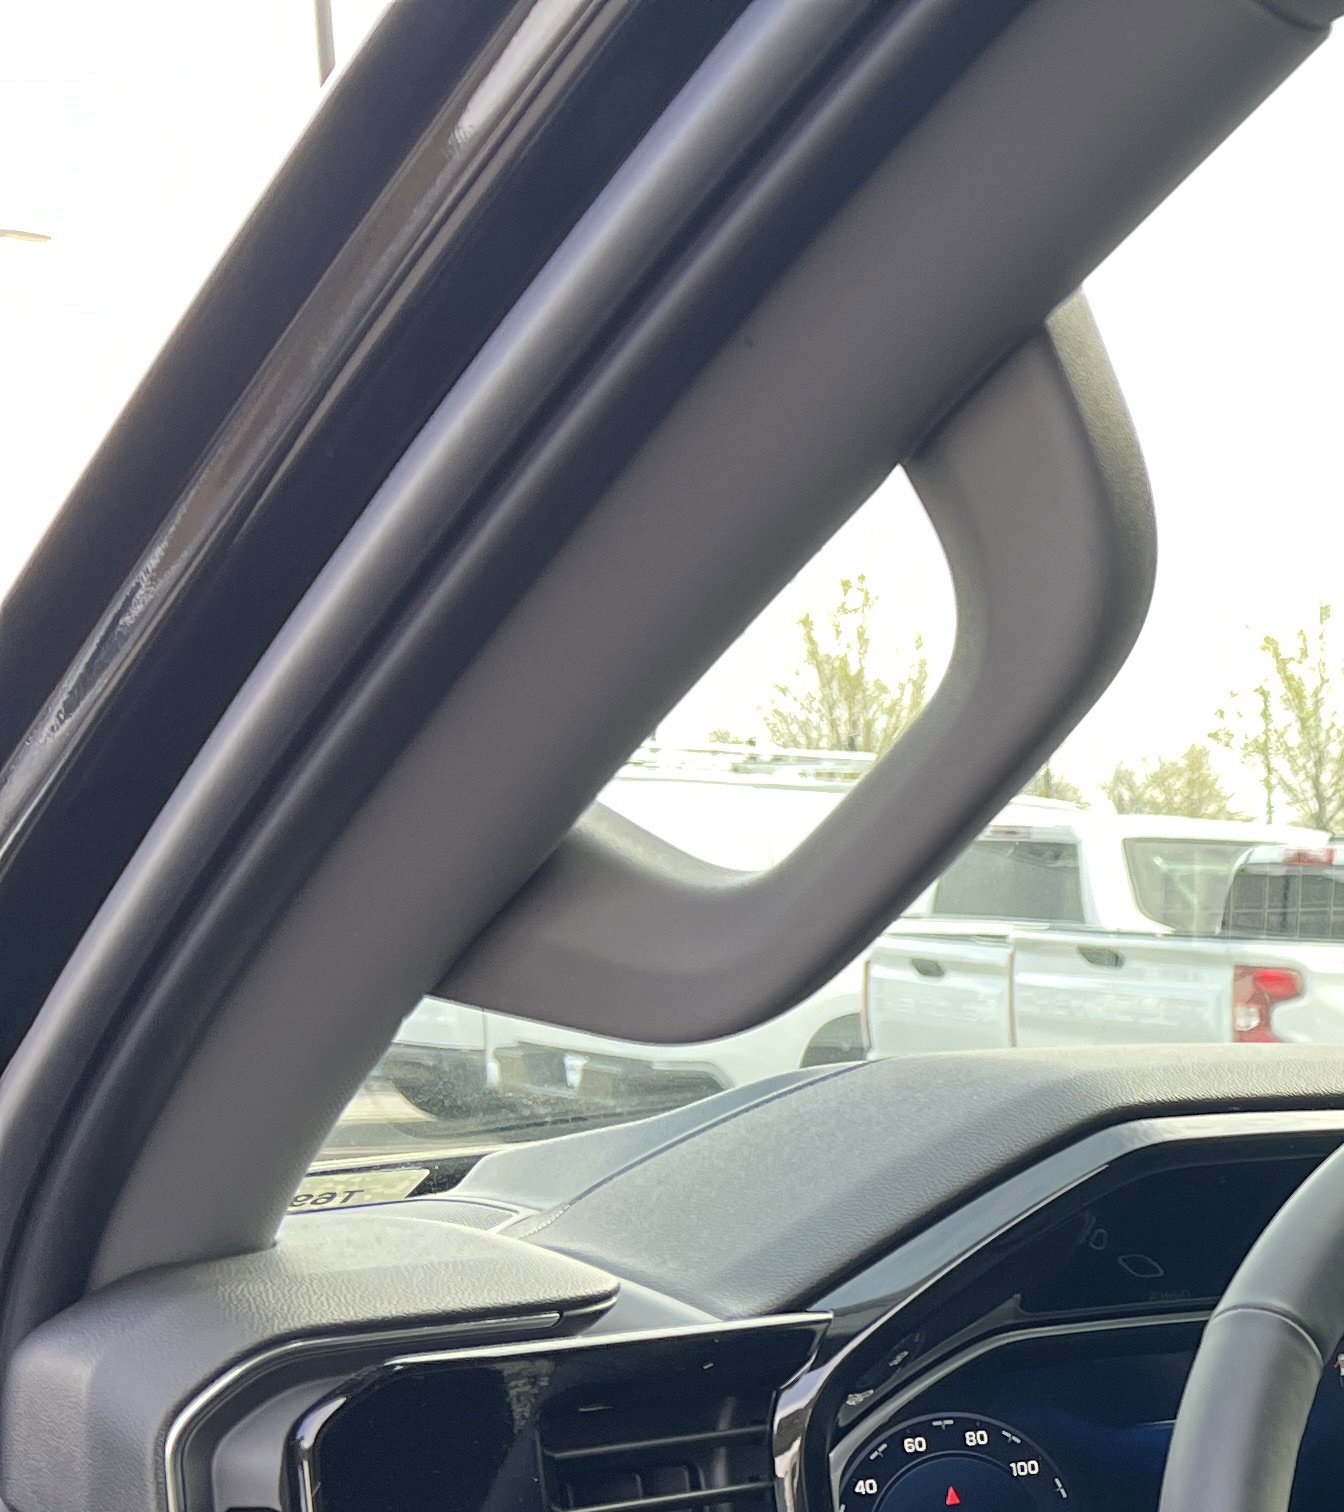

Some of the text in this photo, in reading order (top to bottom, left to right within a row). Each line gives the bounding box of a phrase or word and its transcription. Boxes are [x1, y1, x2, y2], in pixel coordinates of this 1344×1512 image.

[903, 1436, 927, 1453] 60
[964, 1429, 988, 1447] 80
[1009, 1459, 1039, 1478] 100
[854, 1478, 878, 1495] 40
